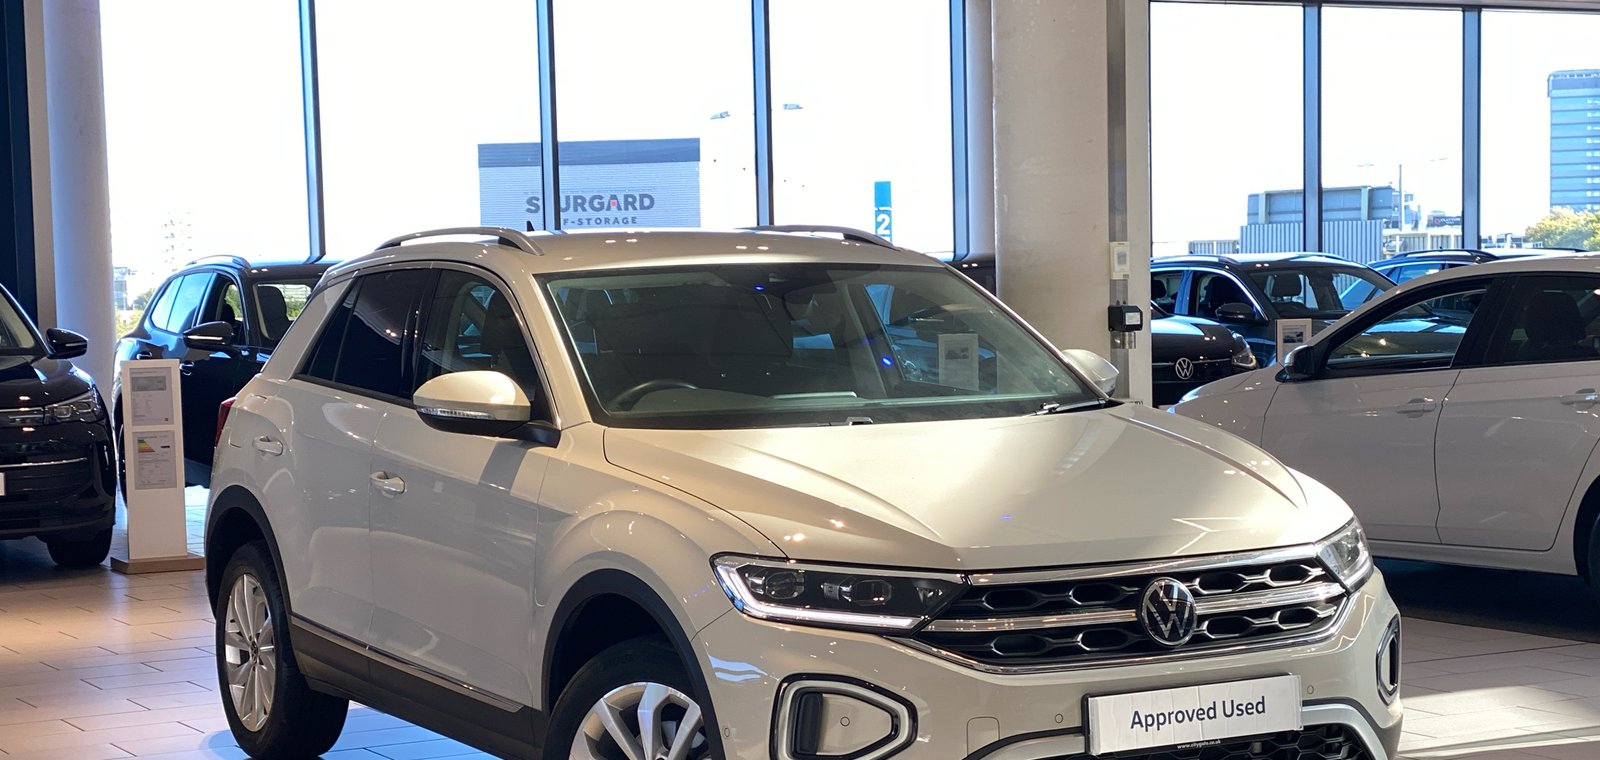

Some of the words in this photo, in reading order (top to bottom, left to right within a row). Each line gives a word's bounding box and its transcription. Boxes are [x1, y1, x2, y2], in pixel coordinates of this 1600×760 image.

[526, 193, 655, 214] SURGARD
[563, 216, 638, 226] F-STORAGE
[876, 213, 891, 235] 2
[1130, 701, 1217, 732] Approved
[1222, 696, 1266, 718] Used
